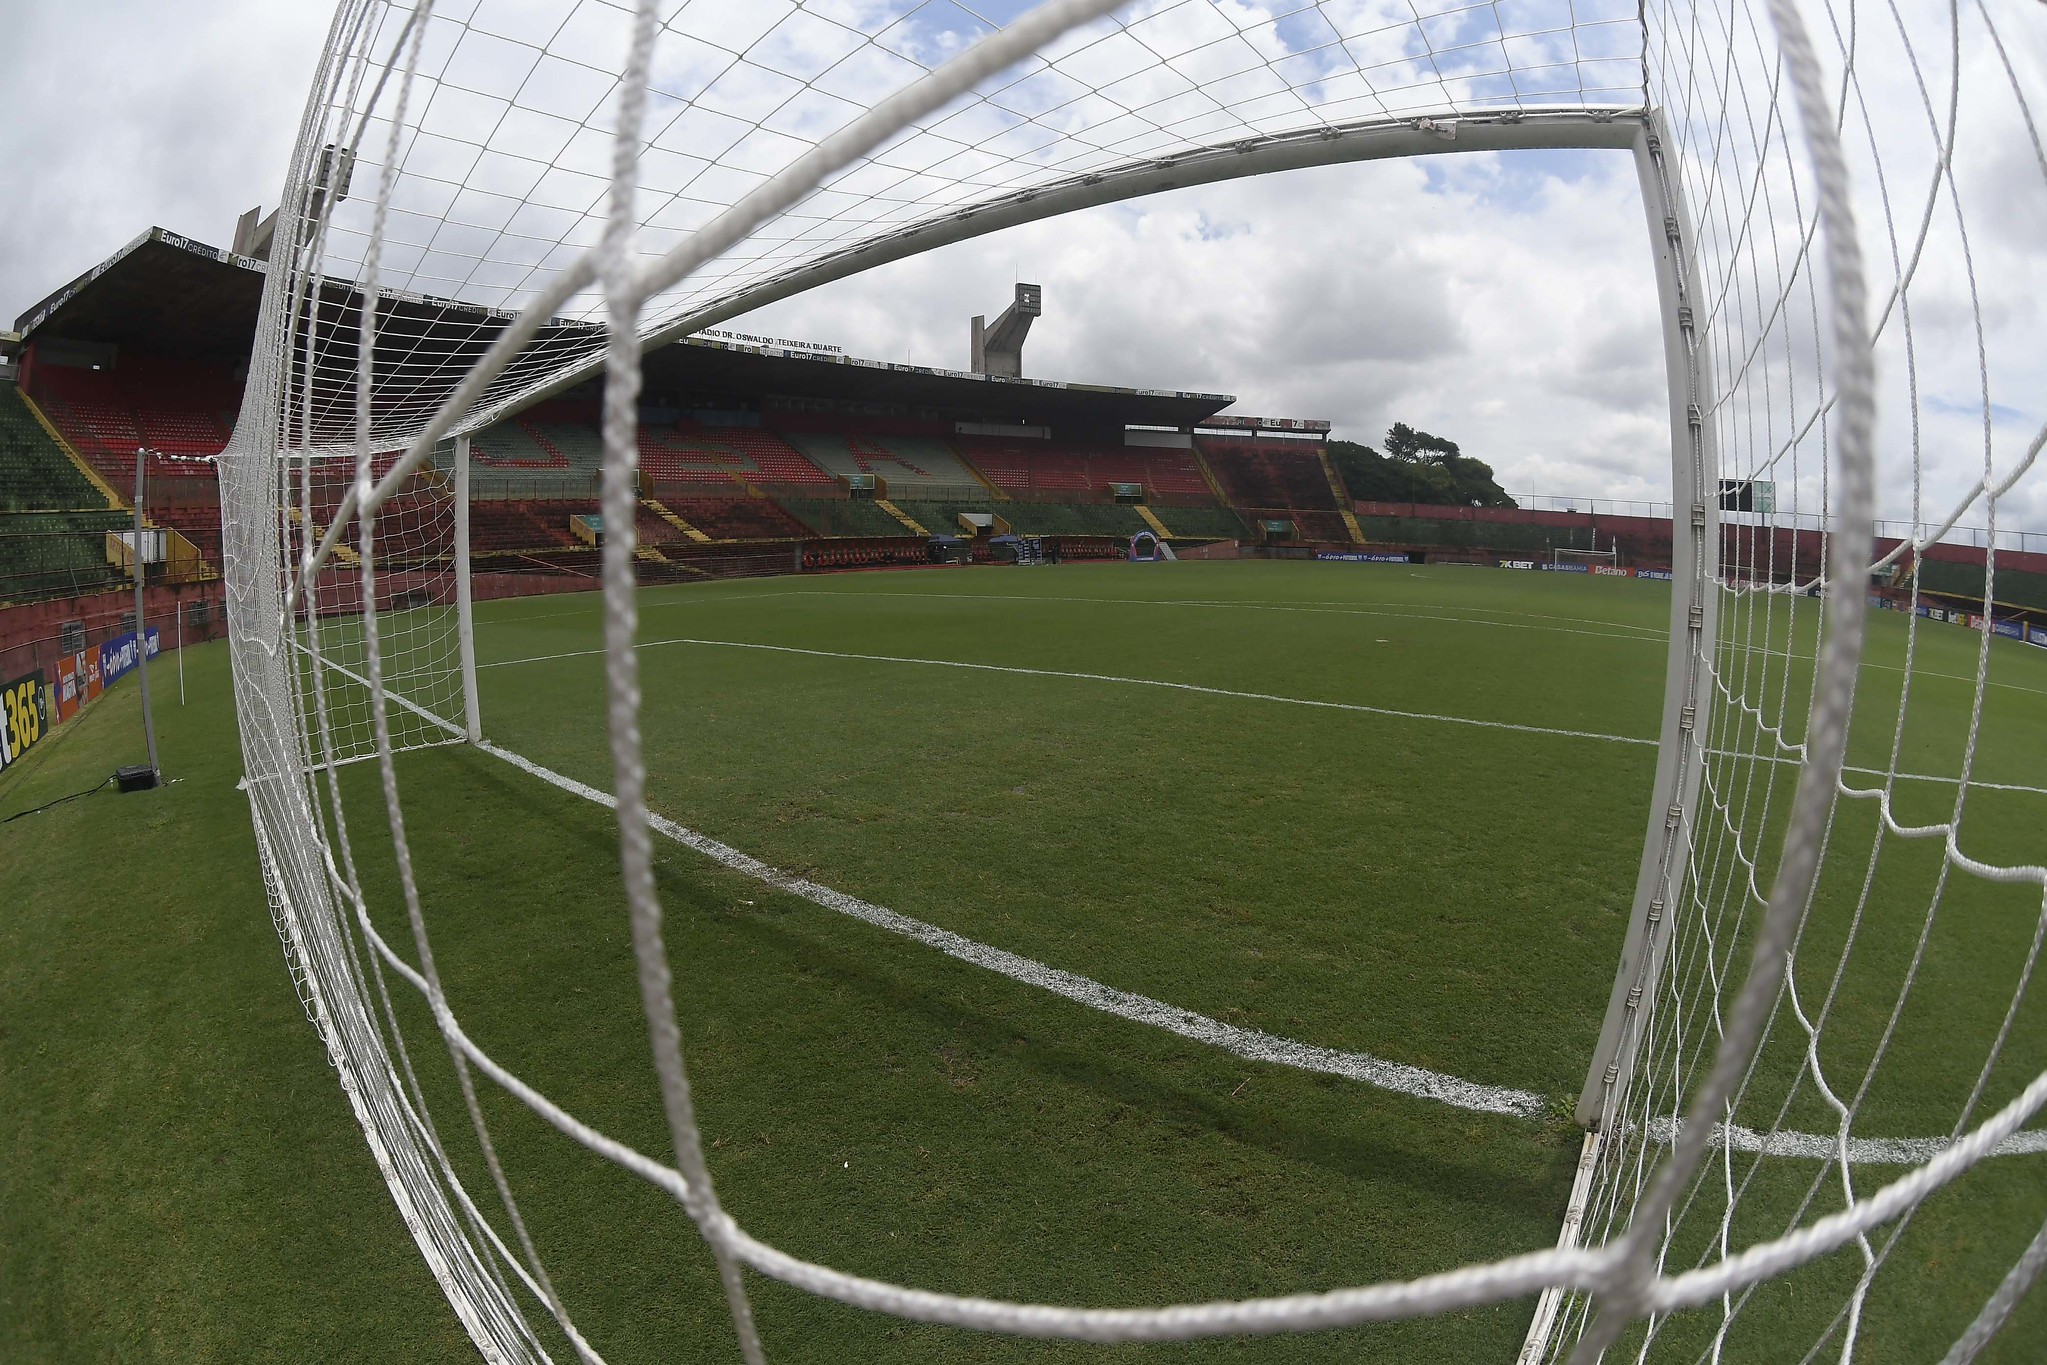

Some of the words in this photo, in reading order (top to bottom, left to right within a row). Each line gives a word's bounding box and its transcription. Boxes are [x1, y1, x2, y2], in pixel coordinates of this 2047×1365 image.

[736, 333, 773, 345] OSWALDO
[777, 339, 811, 349] TEIXEIRA
[813, 344, 842, 353] DUARTE
[1594, 566, 1628, 576] Betano
[0, 680, 39, 772] t365
